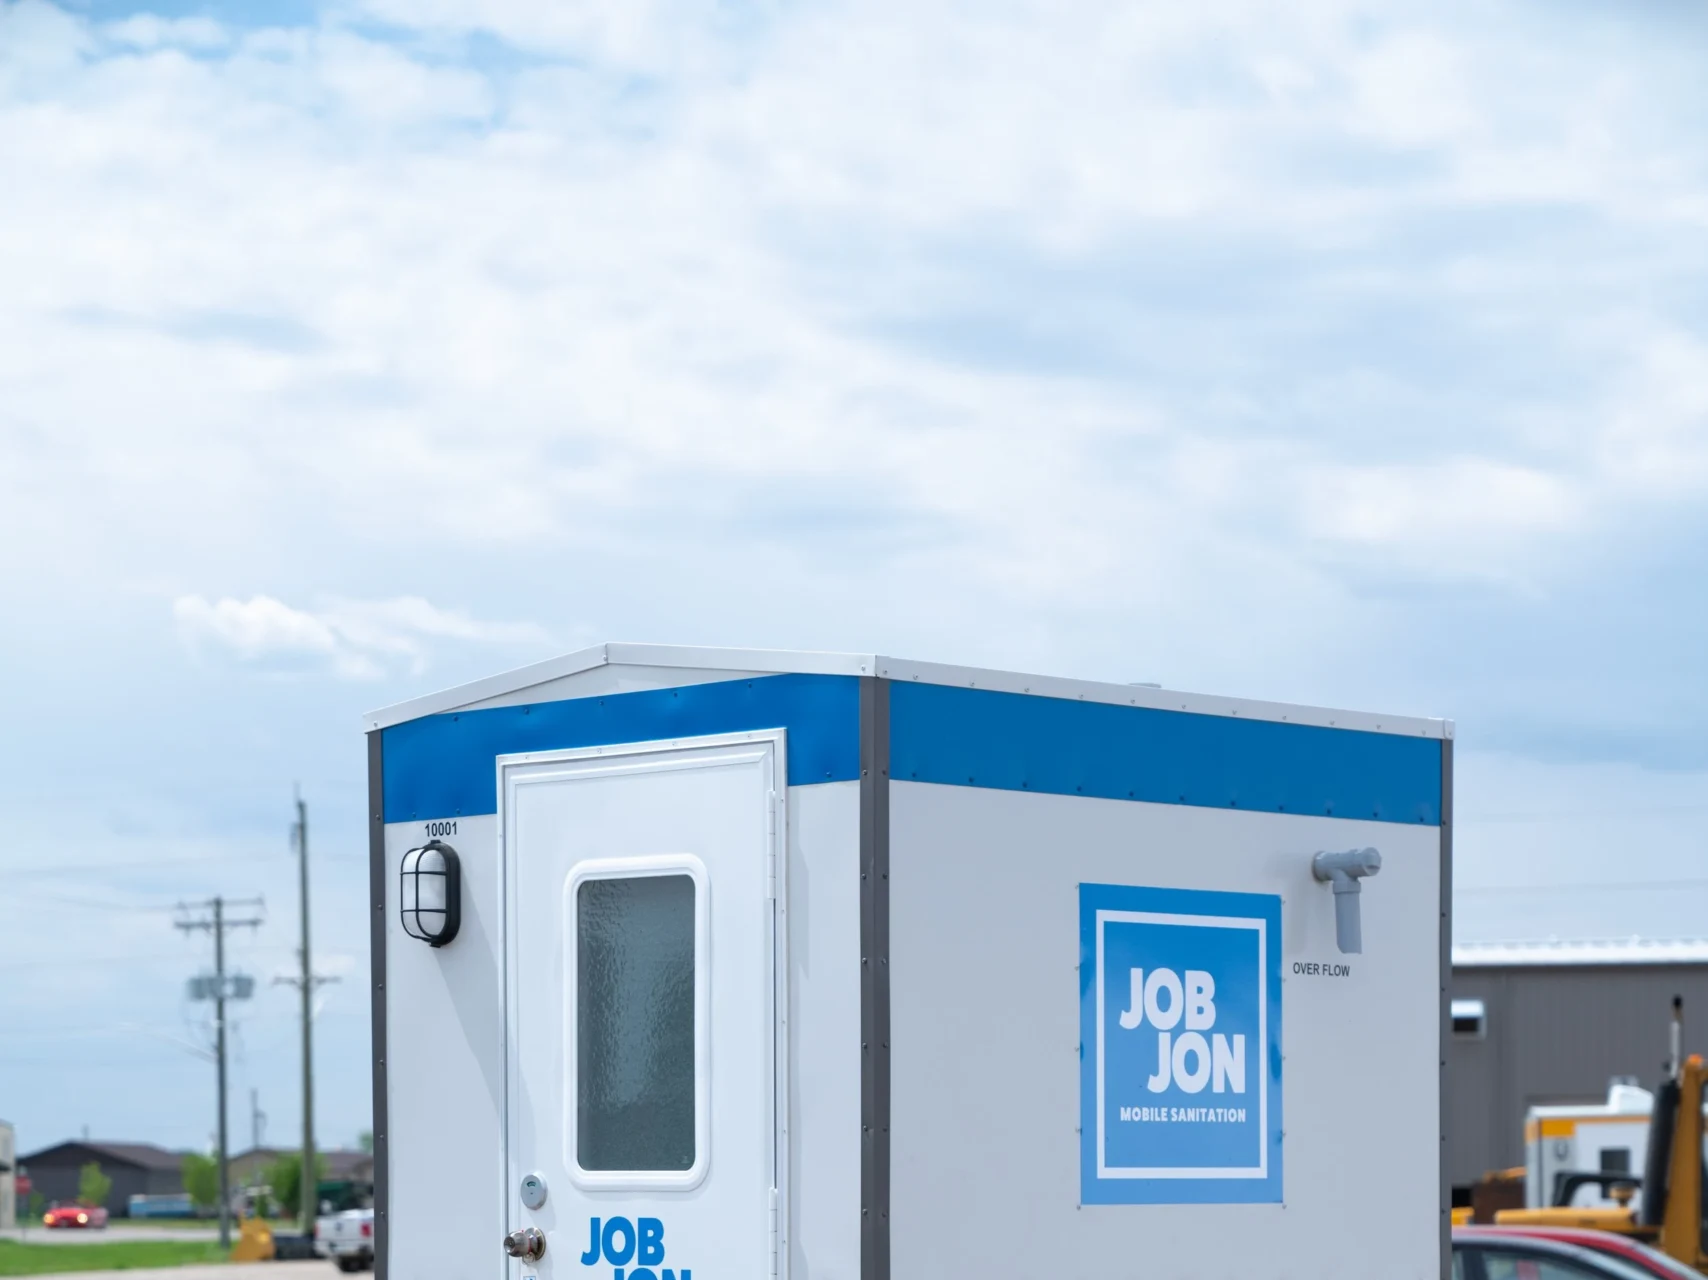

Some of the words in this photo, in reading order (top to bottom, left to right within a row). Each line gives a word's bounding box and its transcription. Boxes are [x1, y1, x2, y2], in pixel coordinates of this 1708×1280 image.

[425, 821, 457, 837] 10001
[1293, 962, 1320, 976] OVER
[1322, 963, 1350, 977] FLOW
[1119, 967, 1216, 1030] JOB
[1147, 1031, 1246, 1094] JON
[1120, 1107, 1168, 1122] MOBILE
[1171, 1108, 1246, 1123] SANITATION
[580, 1216, 665, 1266] JOB
